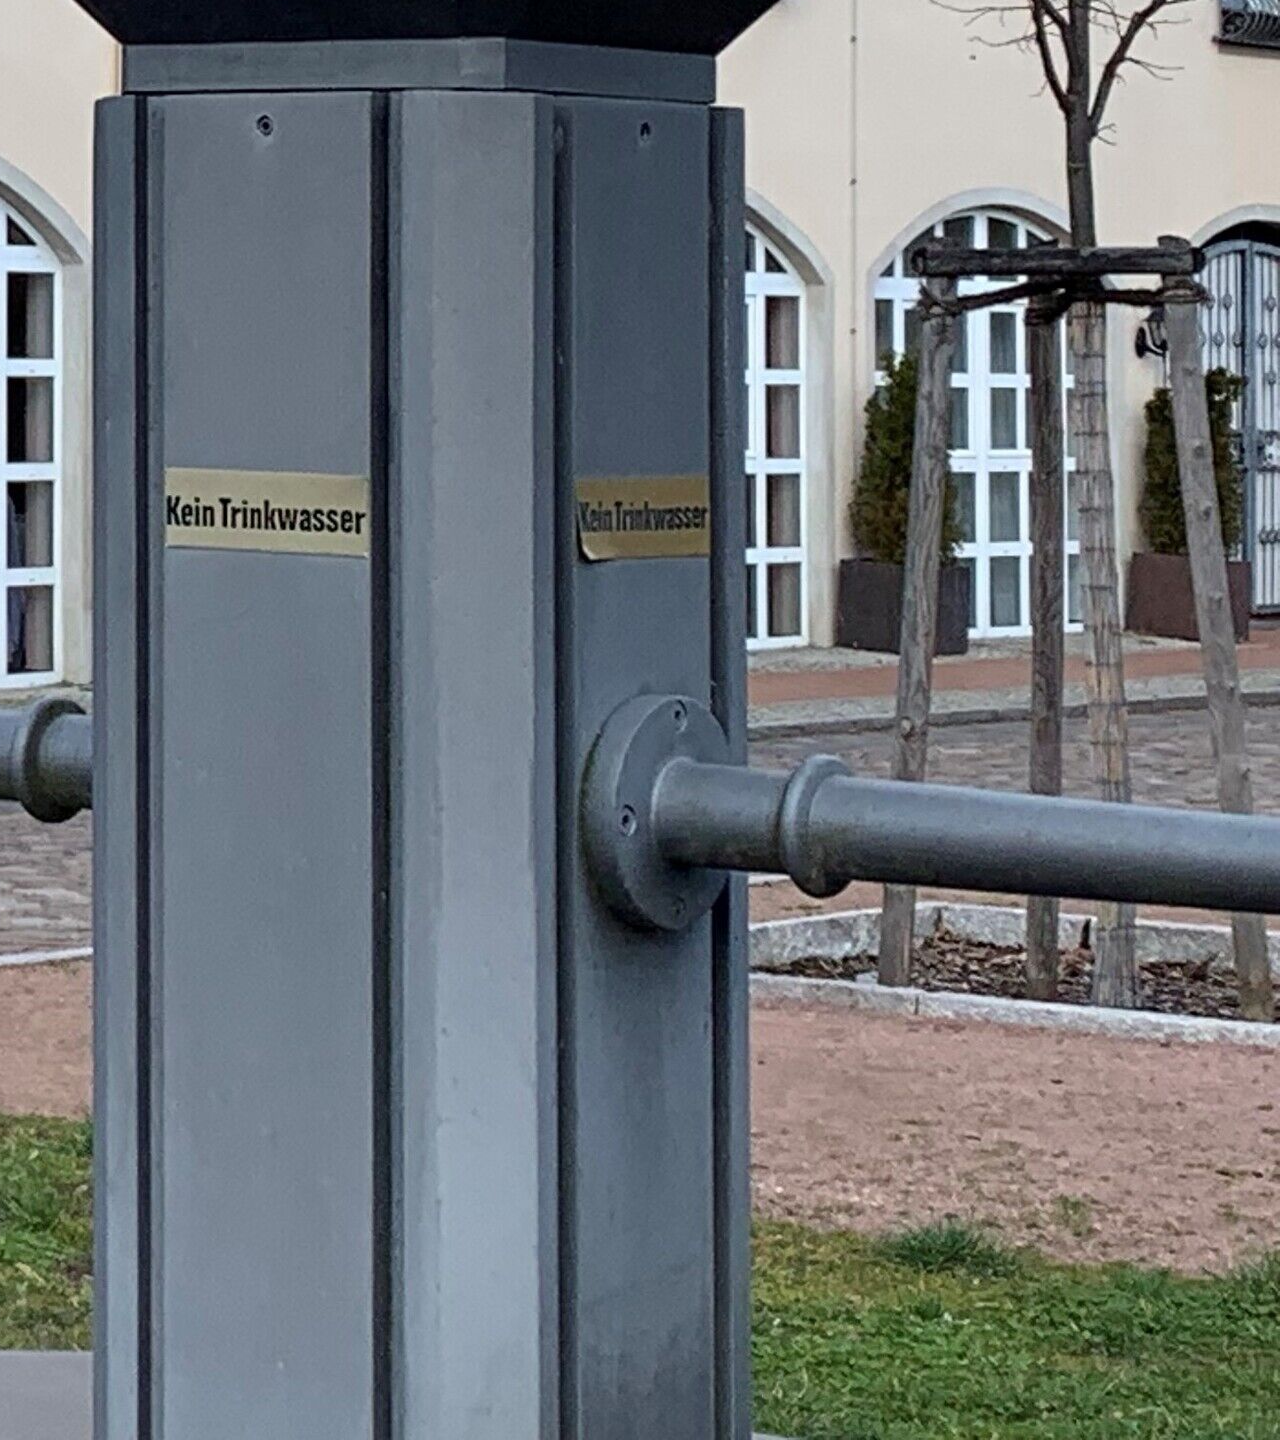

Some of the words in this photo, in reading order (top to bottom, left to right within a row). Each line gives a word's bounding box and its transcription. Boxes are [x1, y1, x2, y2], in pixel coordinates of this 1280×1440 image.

[166, 495, 216, 528] Kein
[218, 497, 366, 535] Trinkwasser
[578, 500, 613, 533] Kein
[614, 500, 708, 532] Trinkwasser
